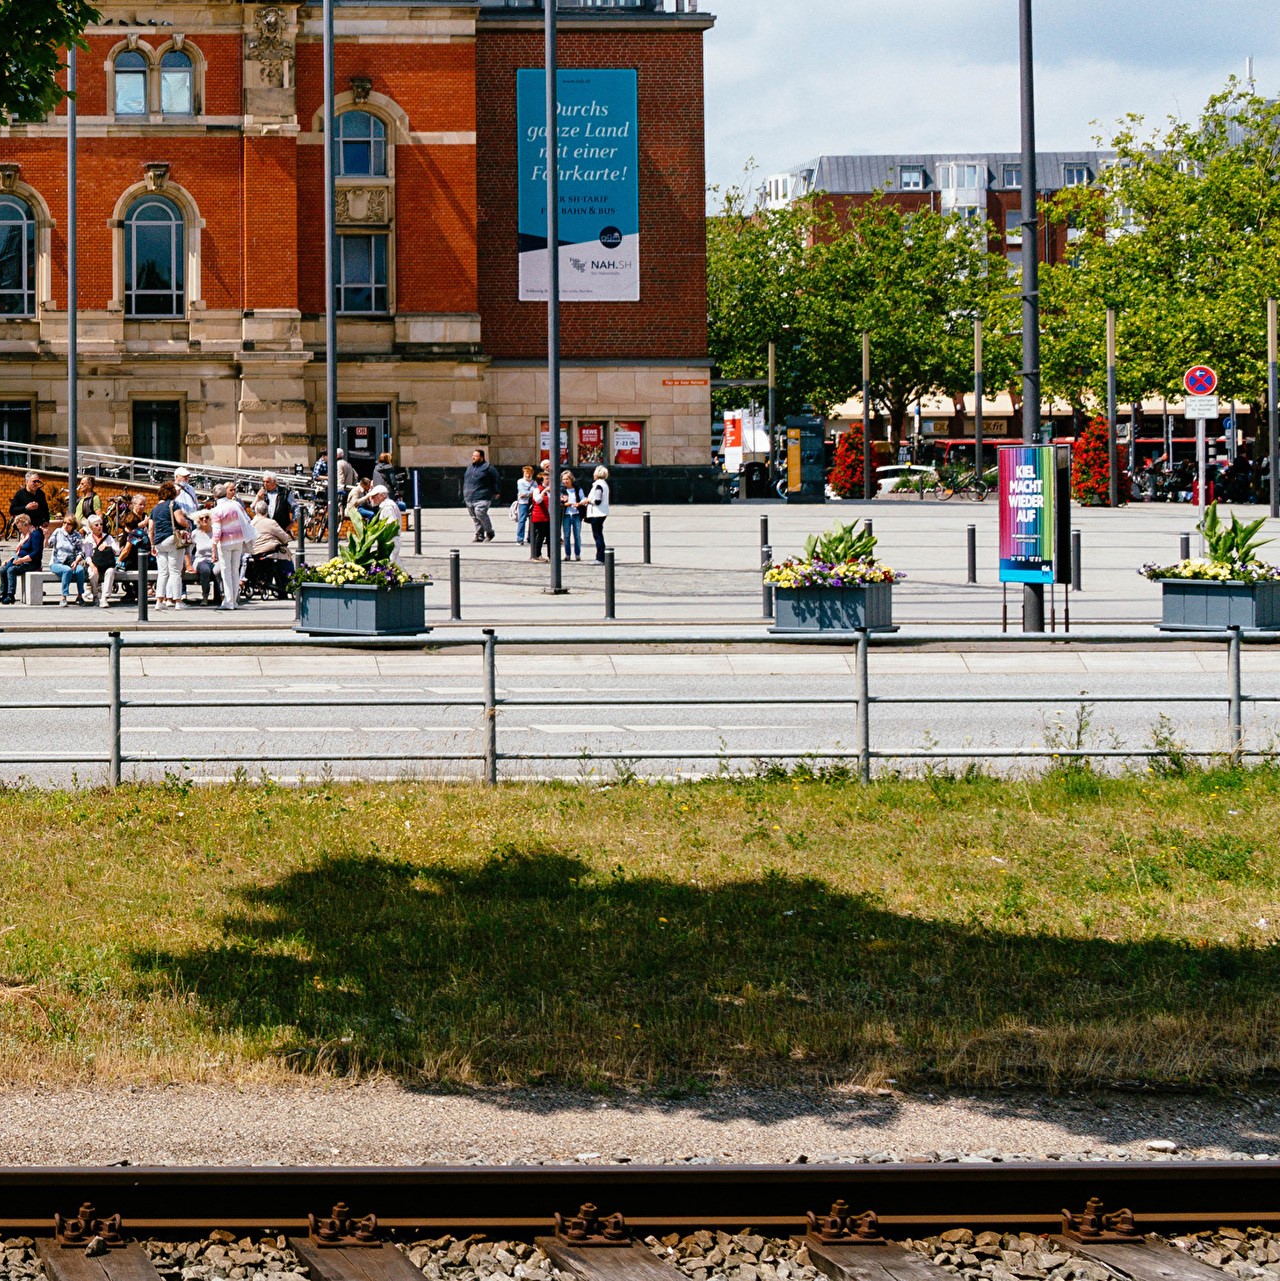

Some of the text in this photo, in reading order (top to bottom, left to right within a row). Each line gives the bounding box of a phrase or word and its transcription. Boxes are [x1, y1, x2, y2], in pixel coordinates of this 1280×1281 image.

[527, 121, 630, 141] gaze Land
[573, 143, 618, 159] einer
[561, 207, 587, 215] BAHN
[588, 206, 597, 215] &
[598, 207, 616, 215] BUS
[591, 260, 632, 269] NAH.SH
[1015, 465, 1036, 479] KIEL
[1009, 480, 1043, 493] MACHT
[1008, 494, 1044, 508] WIEDER
[1016, 509, 1037, 523] AUF
